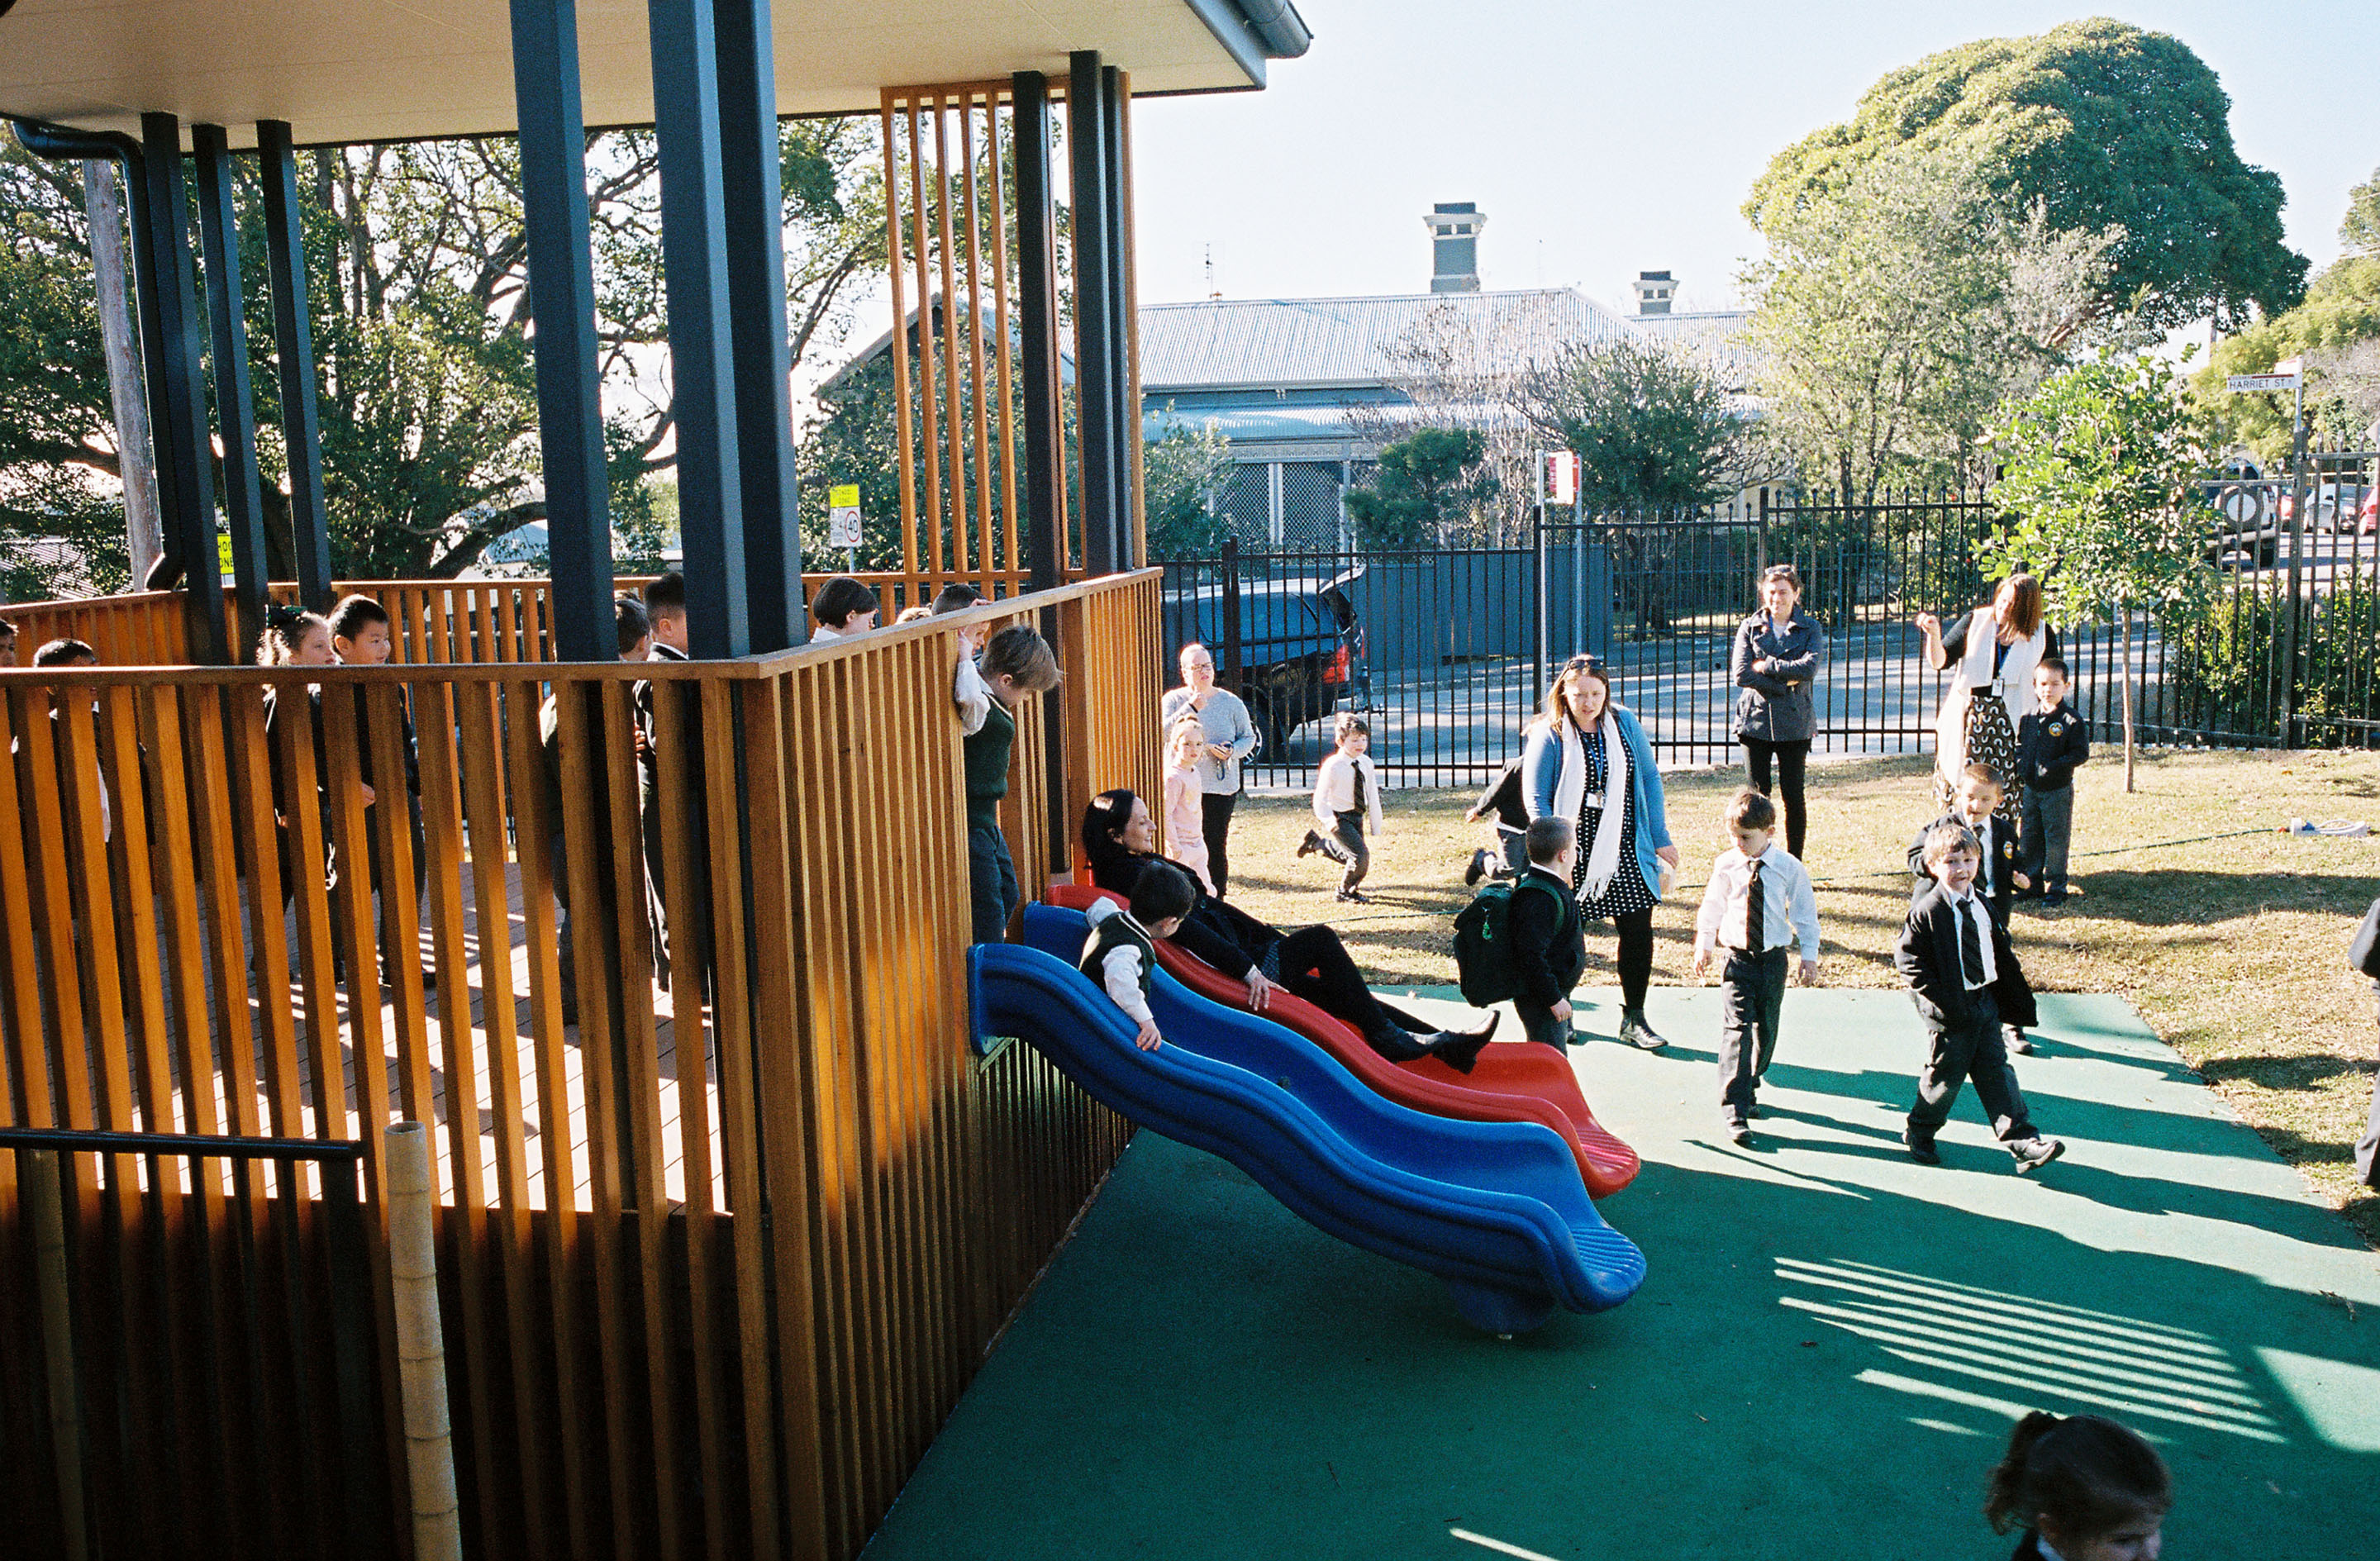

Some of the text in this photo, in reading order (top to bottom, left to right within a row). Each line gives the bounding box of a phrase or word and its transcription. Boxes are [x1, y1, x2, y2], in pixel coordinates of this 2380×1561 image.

[2229, 378, 2285, 389] HARRIET ST
[848, 520, 858, 533] 40
[219, 557, 233, 568] ONE
